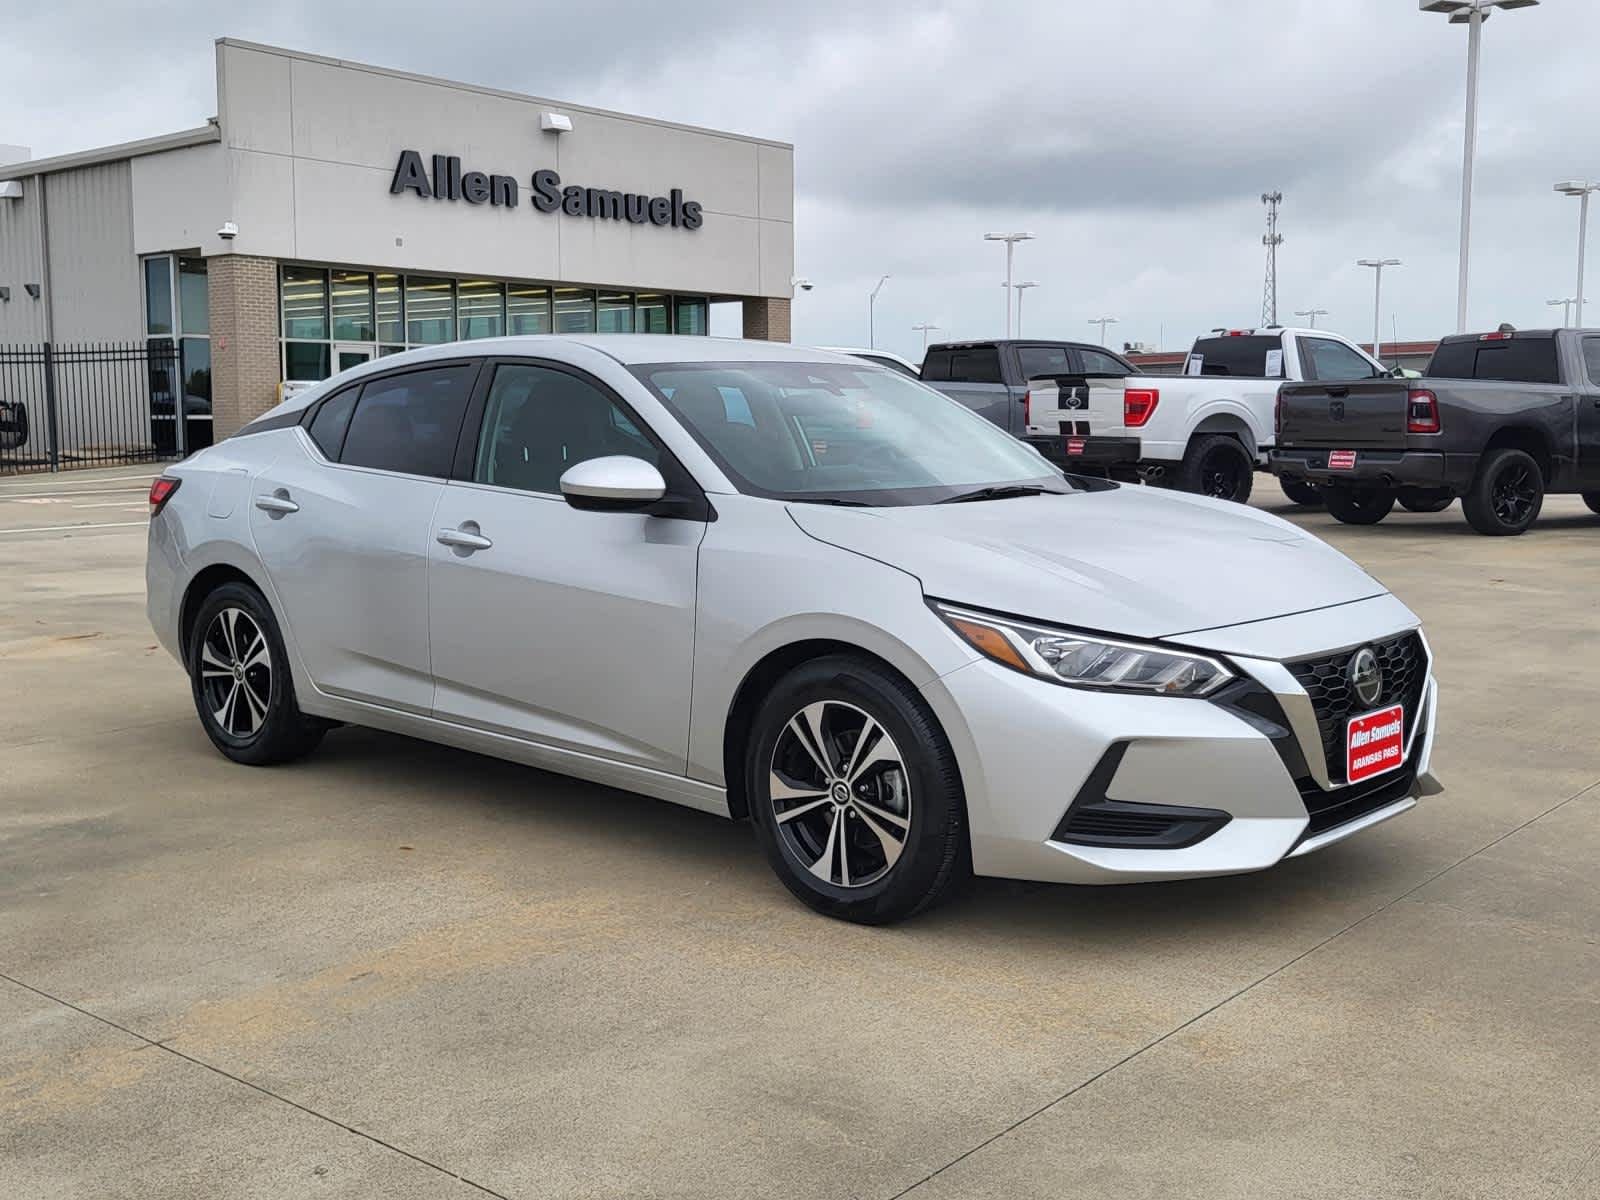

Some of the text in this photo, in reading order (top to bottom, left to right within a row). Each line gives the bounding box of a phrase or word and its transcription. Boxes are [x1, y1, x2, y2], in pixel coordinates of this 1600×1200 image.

[390, 150, 703, 230] Allen Samuels
[1351, 719, 1400, 749] Allen Samuels
[1352, 745, 1399, 771] ARANSAS PASS
